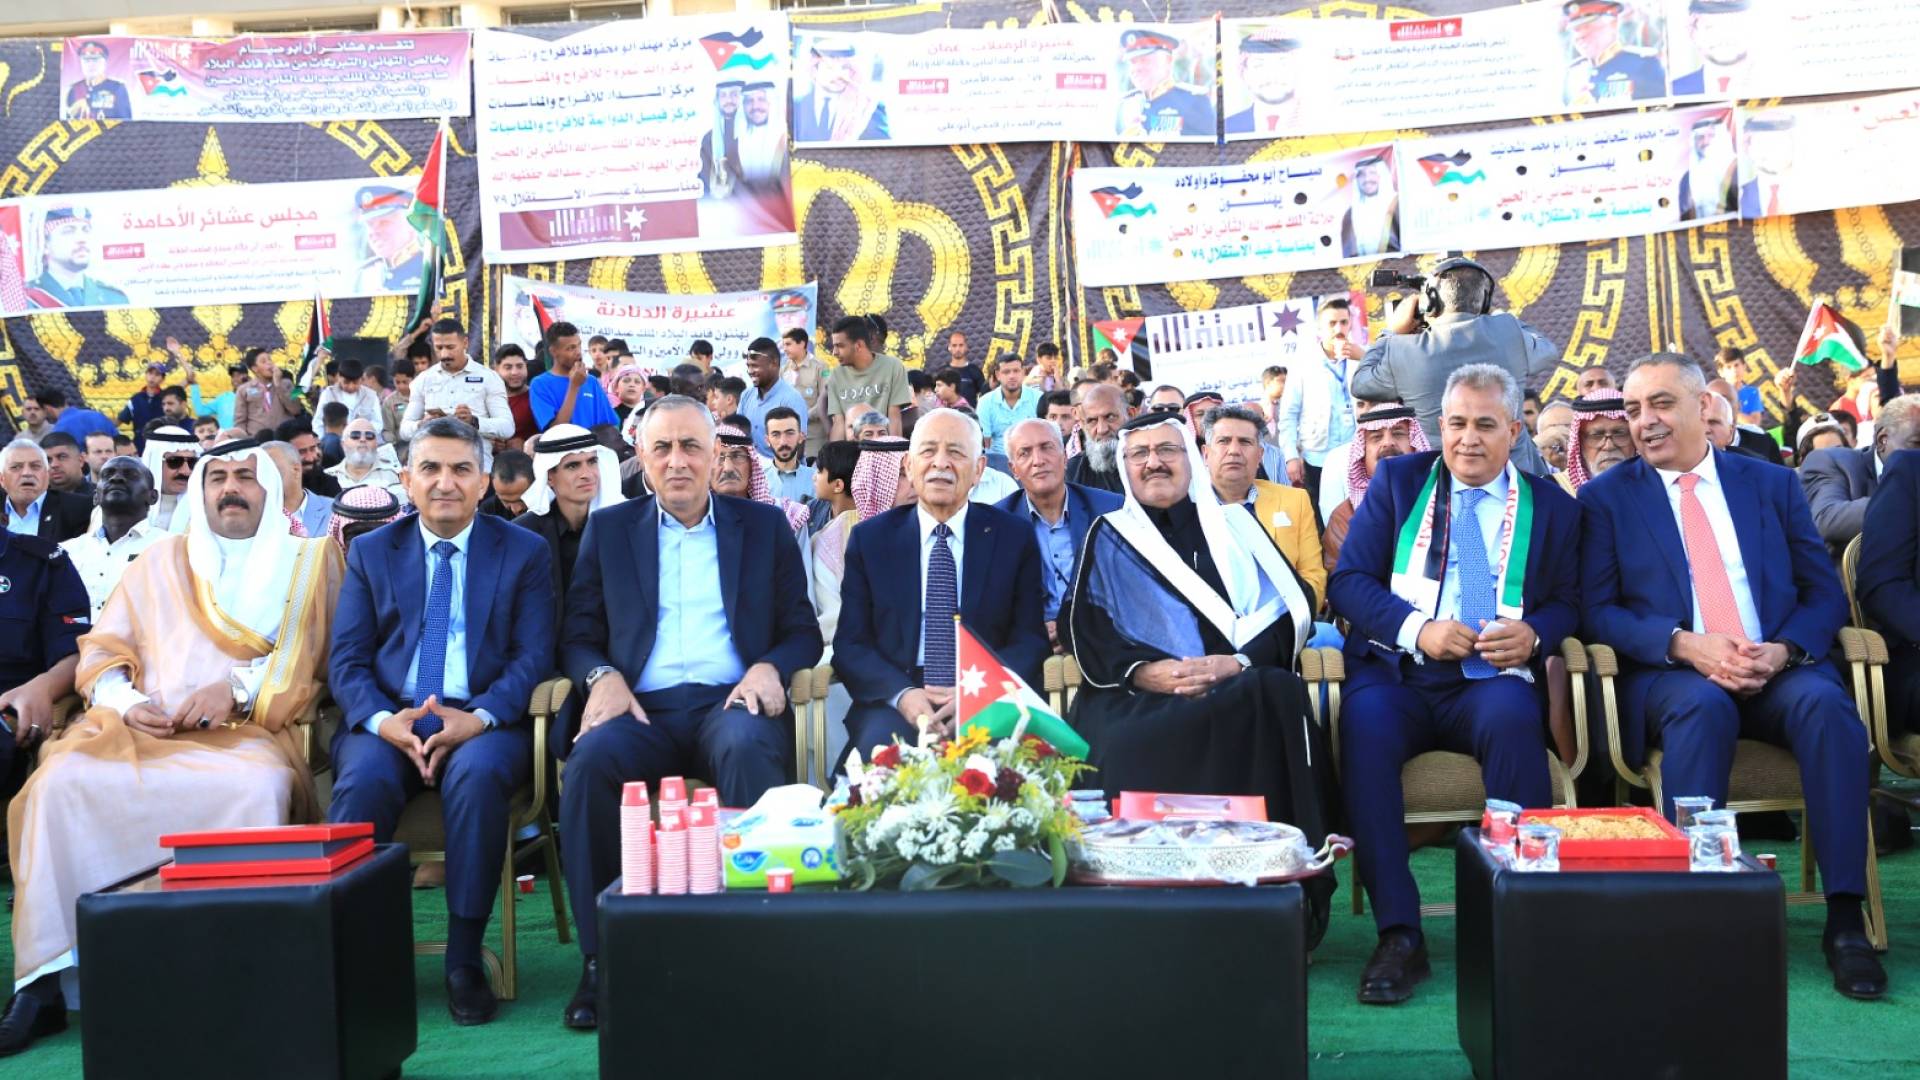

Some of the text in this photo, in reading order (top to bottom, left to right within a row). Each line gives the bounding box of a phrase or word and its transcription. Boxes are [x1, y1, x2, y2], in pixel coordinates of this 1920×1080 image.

[122, 201, 318, 233] مجلس عشائر الأحامدة
[596, 301, 737, 323] عشيرة الدنادنة
[1283, 341, 1297, 354] 79
